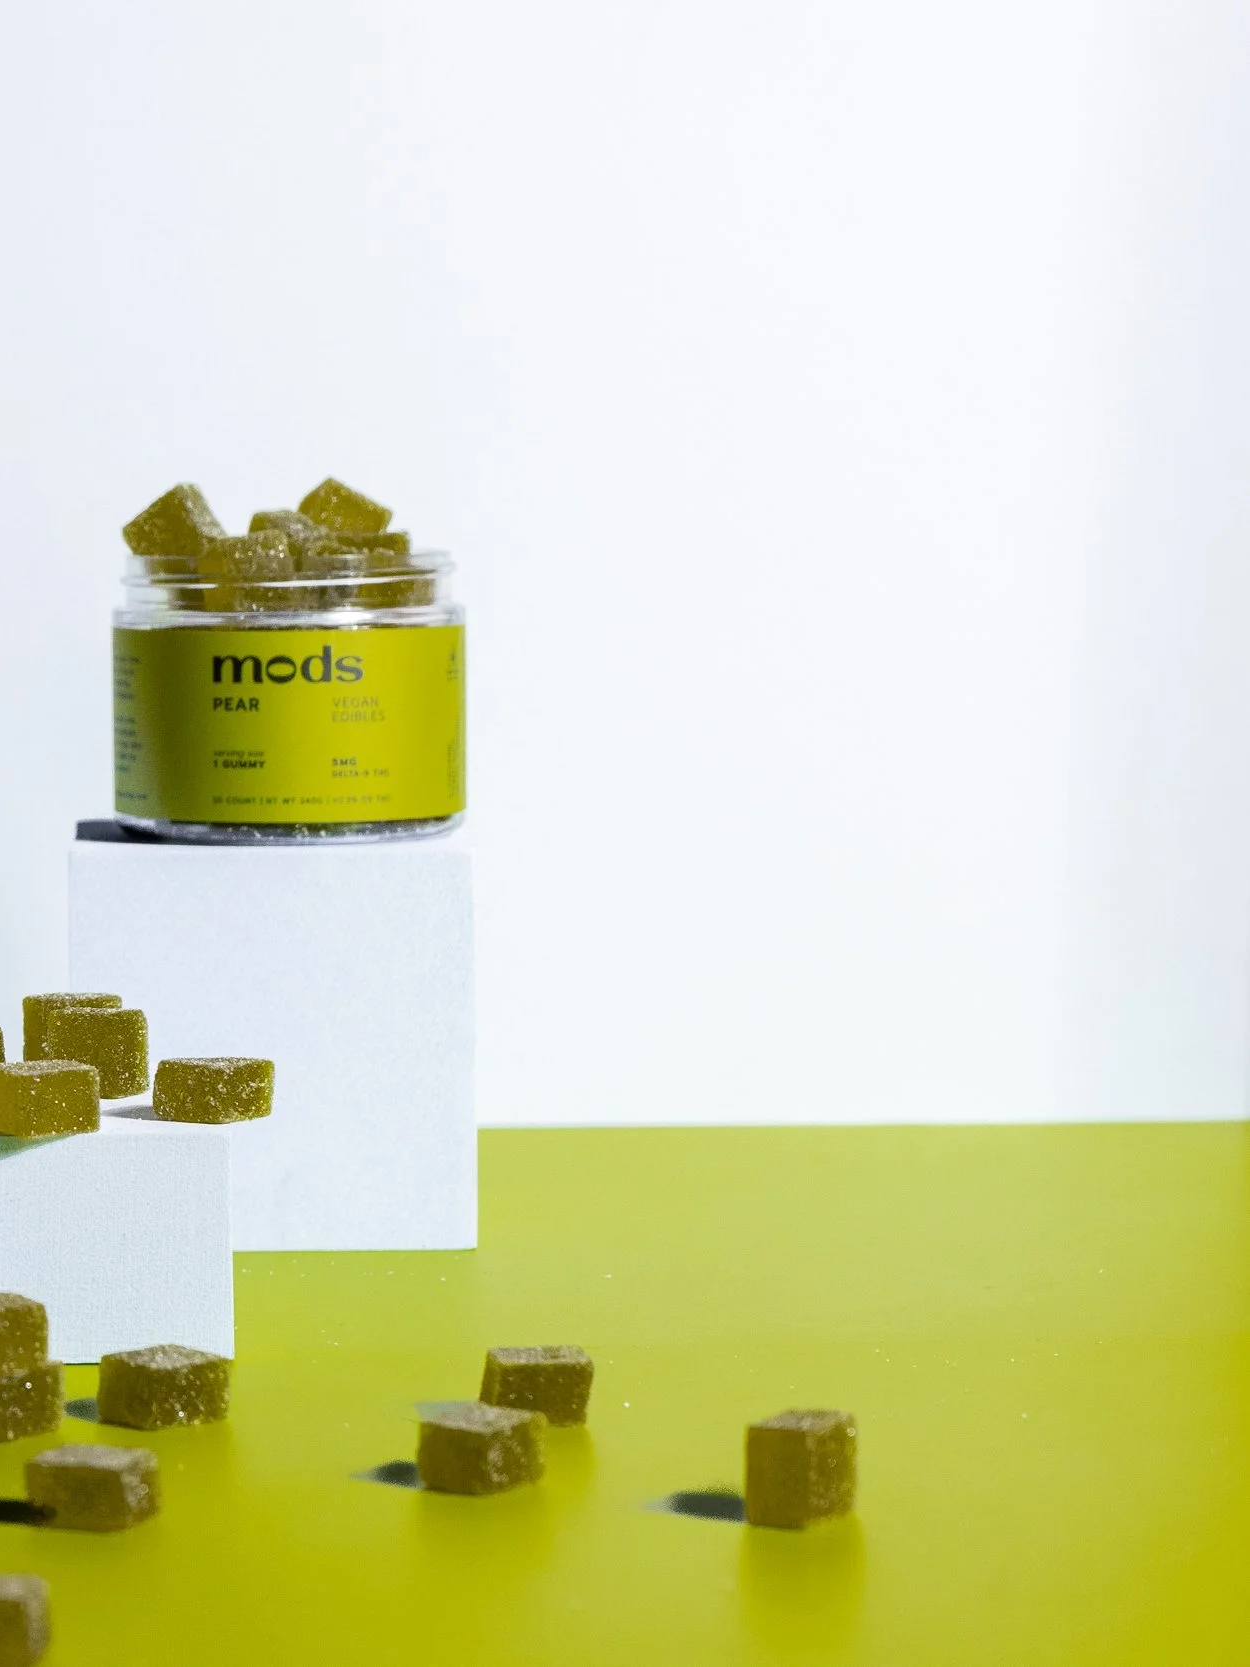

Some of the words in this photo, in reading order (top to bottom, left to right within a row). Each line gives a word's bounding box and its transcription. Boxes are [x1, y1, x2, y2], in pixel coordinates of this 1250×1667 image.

[212, 645, 364, 684] mods
[213, 697, 260, 712] PEAR
[332, 697, 379, 708] VEGAN
[332, 711, 386, 723] EDIBLES
[222, 759, 266, 769] GUMMY
